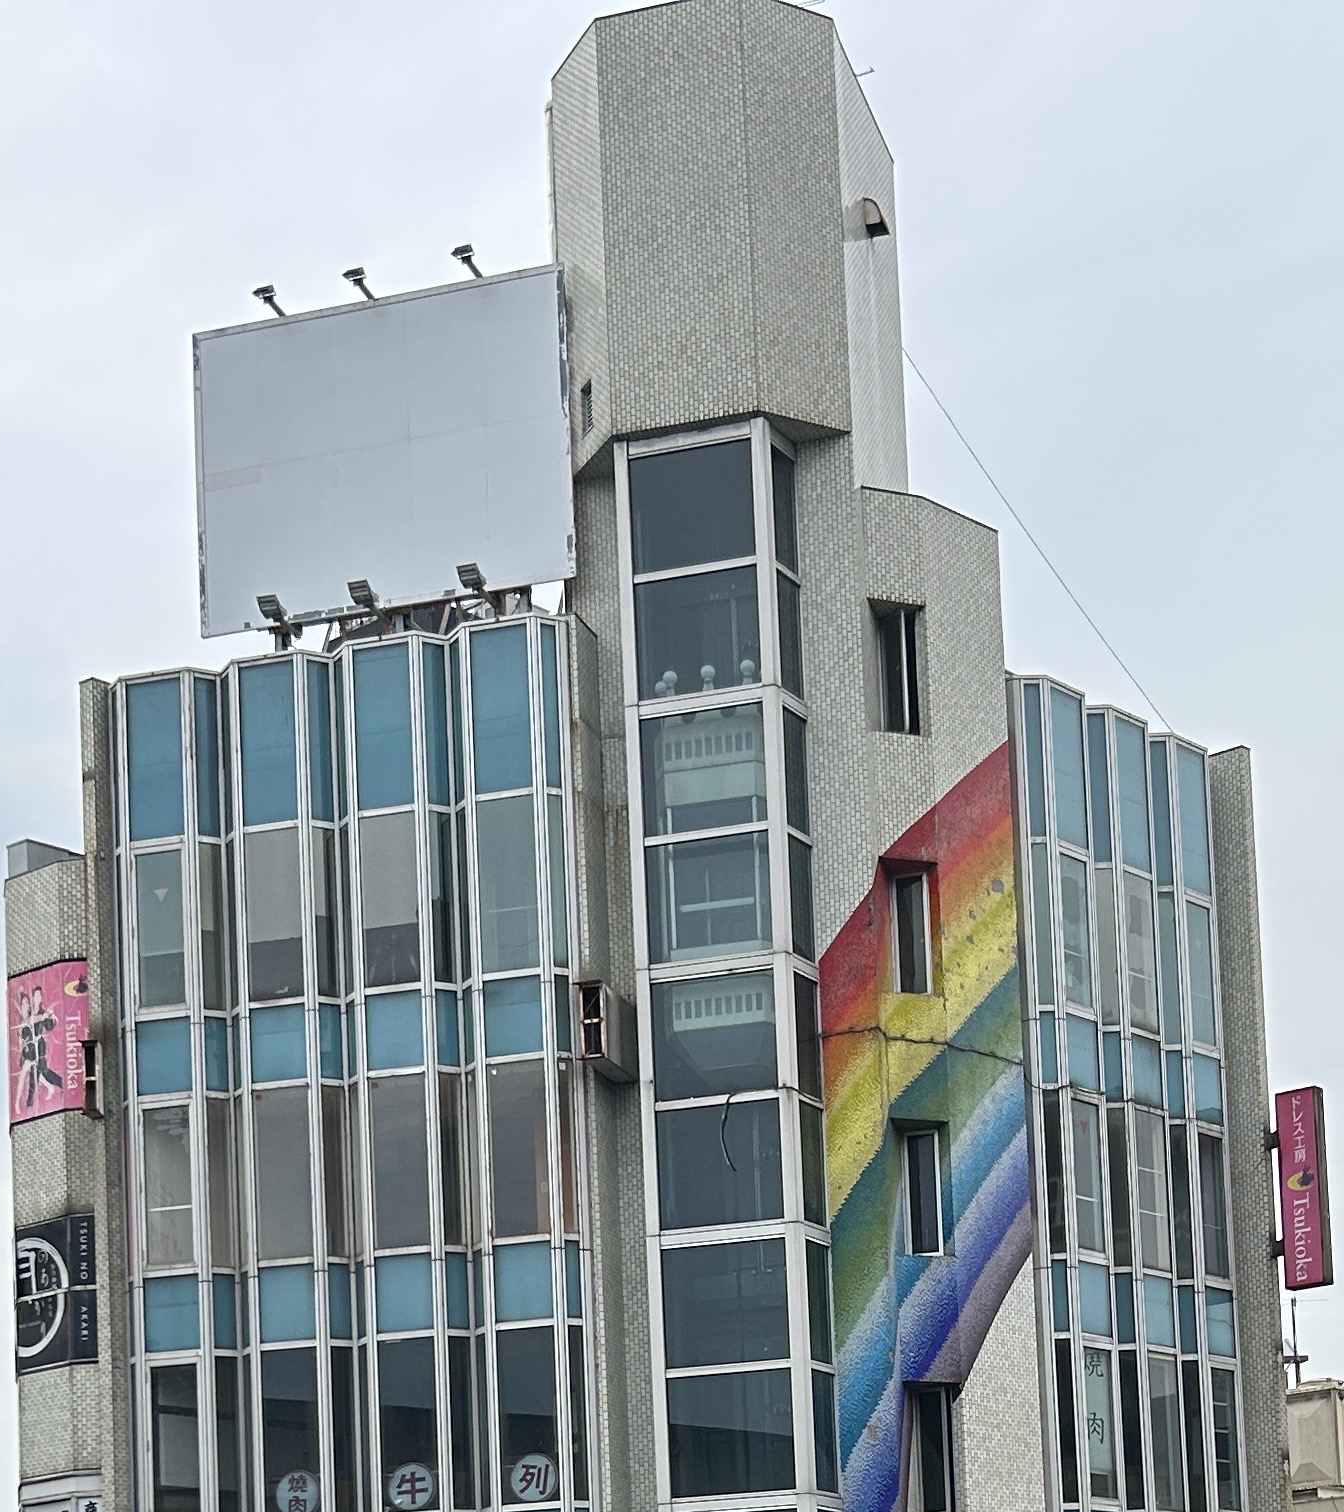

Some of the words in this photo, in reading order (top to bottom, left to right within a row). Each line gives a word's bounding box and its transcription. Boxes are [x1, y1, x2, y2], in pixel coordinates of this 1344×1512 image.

[65, 1011, 84, 1090] Tsukioka
[80, 1222, 88, 1256] TSUKI
[1294, 1192, 1312, 1282] Tsukioka
[80, 1263, 89, 1280] NO
[80, 1306, 89, 1341] AKARI
[396, 1471, 429, 1505] 牛
[519, 1463, 550, 1495] 列
